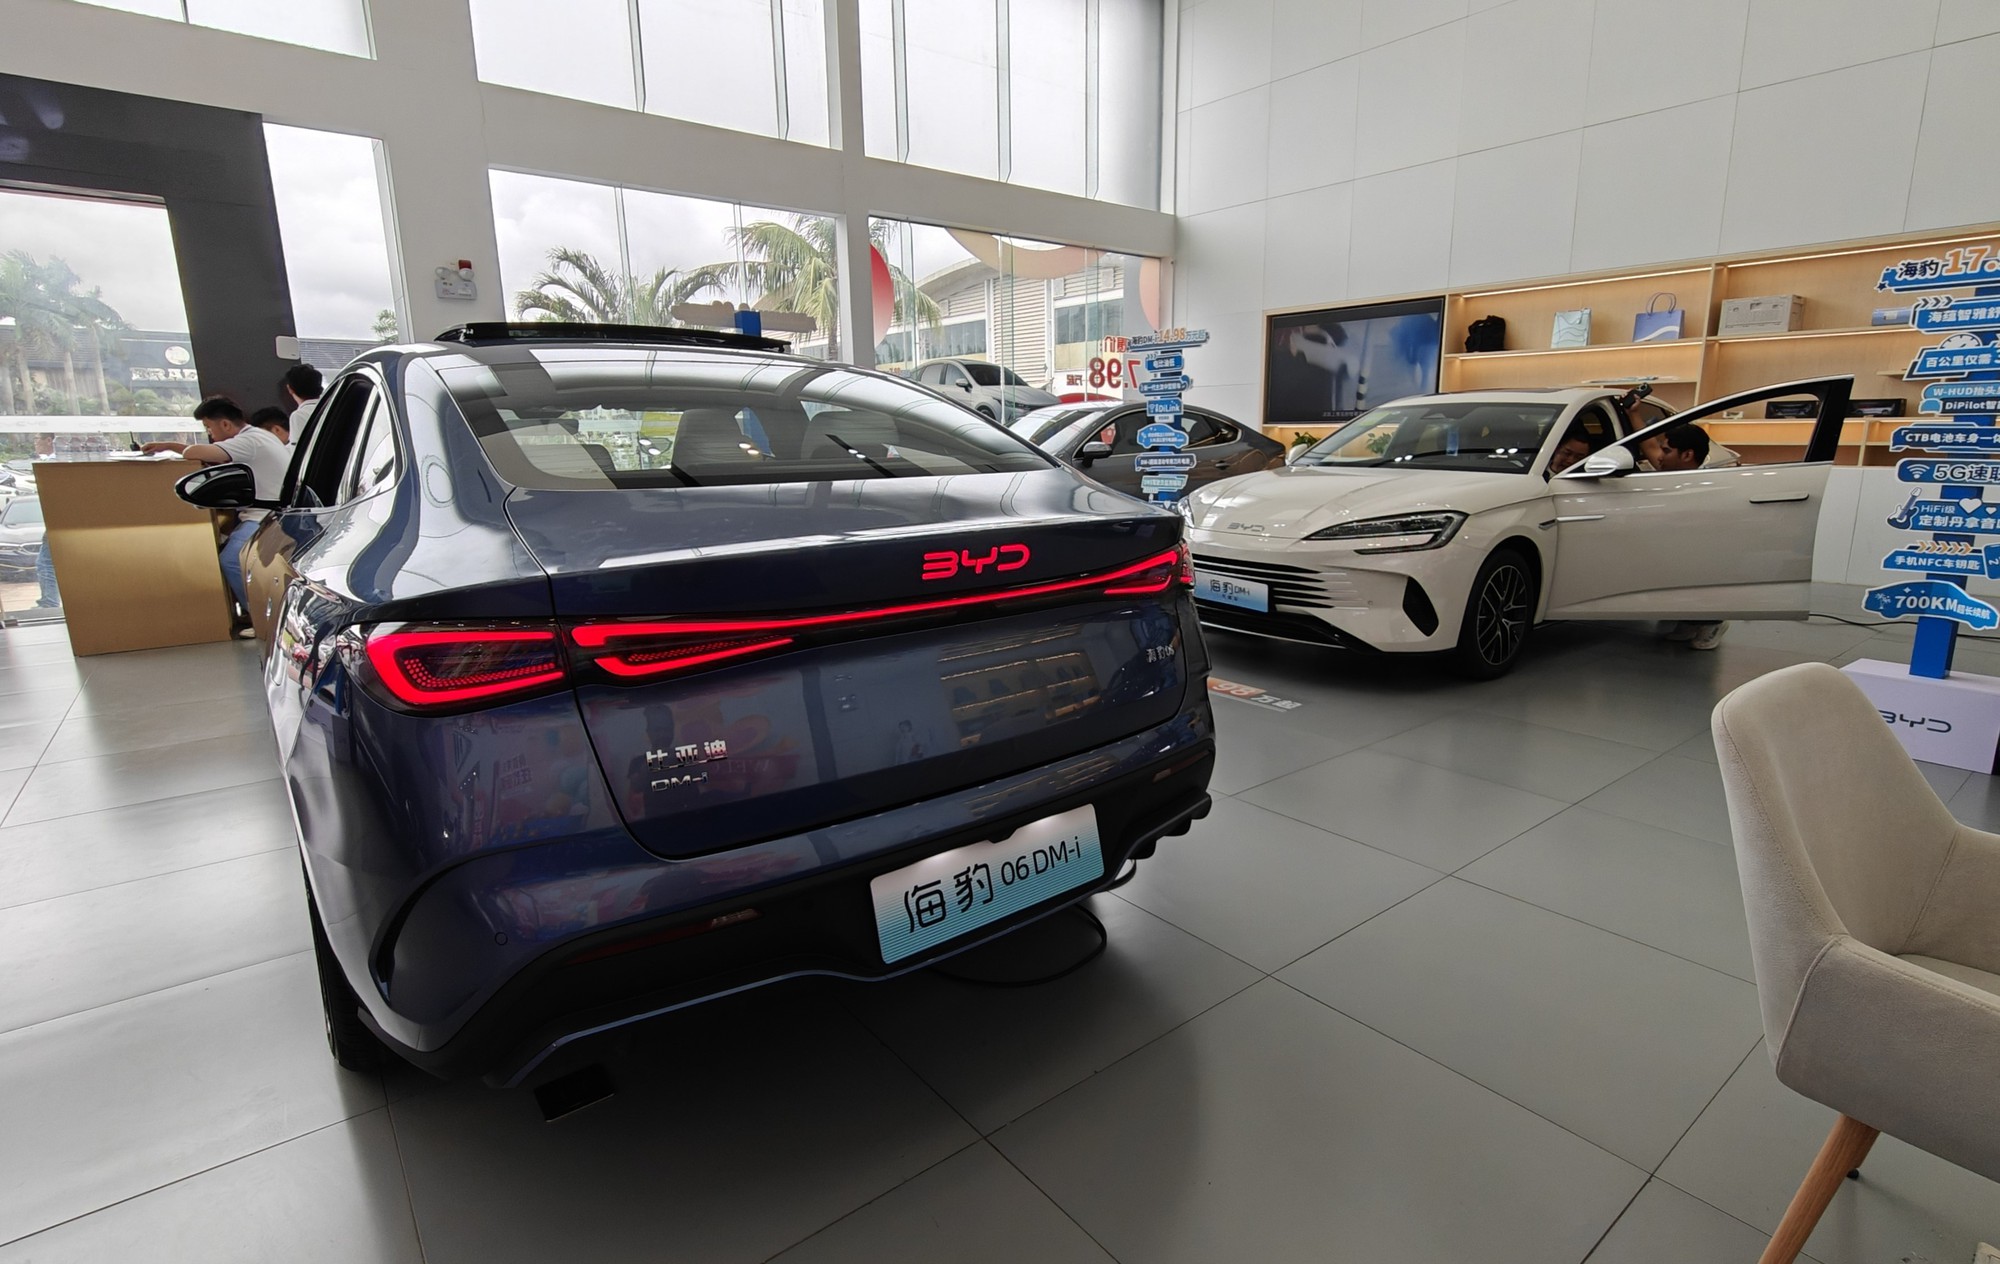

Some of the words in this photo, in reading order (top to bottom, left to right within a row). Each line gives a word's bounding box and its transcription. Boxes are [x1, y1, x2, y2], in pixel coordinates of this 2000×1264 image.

[1898, 259, 1940, 279] 海豹
[1943, 246, 2000, 275] 17.
[1158, 403, 1180, 413] DiLink
[1227, 522, 1265, 532] BYD
[1918, 515, 2000, 530] 定制丹拿音
[922, 543, 1031, 580] BYD
[1895, 555, 1981, 570] 手机NFC车钥匙
[1878, 709, 1951, 733] BYD
[646, 740, 728, 771] 比亚迪
[651, 772, 708, 792] DM-i
[903, 863, 995, 933] 海豹
[1000, 855, 1030, 886] 06
[1032, 836, 1081, 875] DM-i
